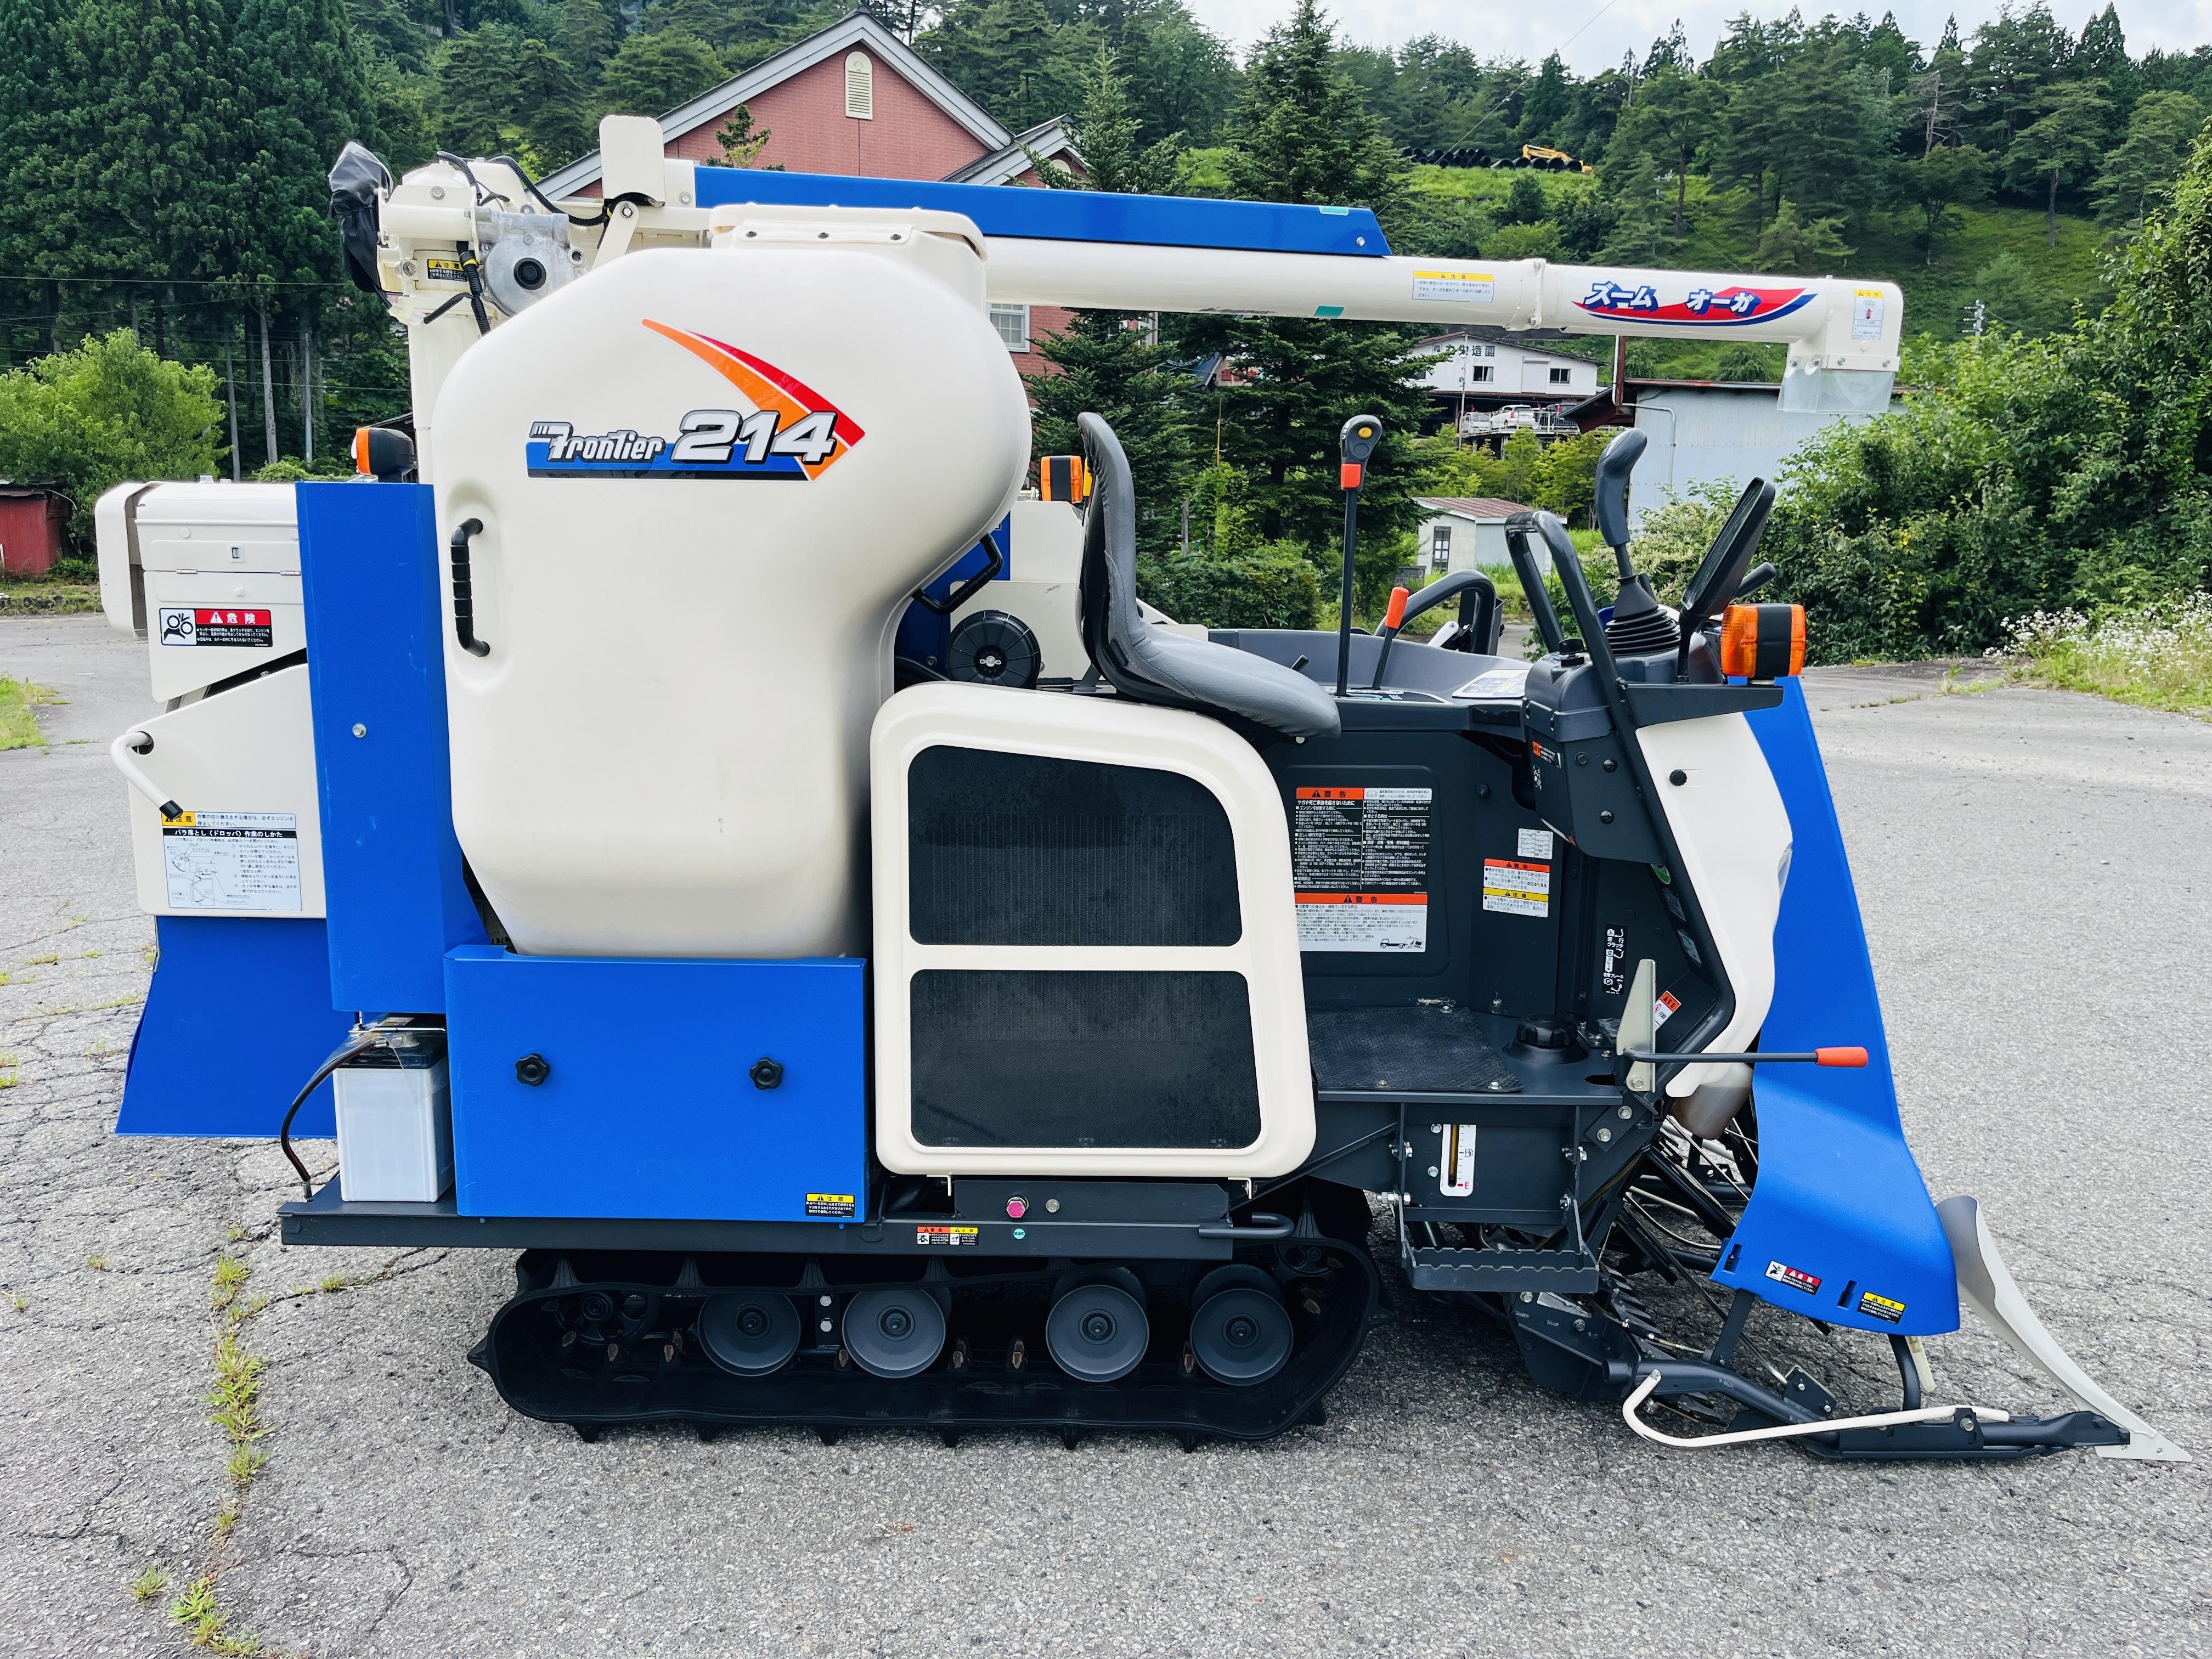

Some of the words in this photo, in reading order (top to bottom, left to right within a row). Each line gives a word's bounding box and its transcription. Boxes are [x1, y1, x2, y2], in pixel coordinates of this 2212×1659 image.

[1584, 281, 1659, 311] ズーム
[1685, 289, 1762, 317] オーガ
[529, 421, 666, 462] Frontier
[670, 409, 838, 464] 214
[227, 612, 256, 624] 危険
